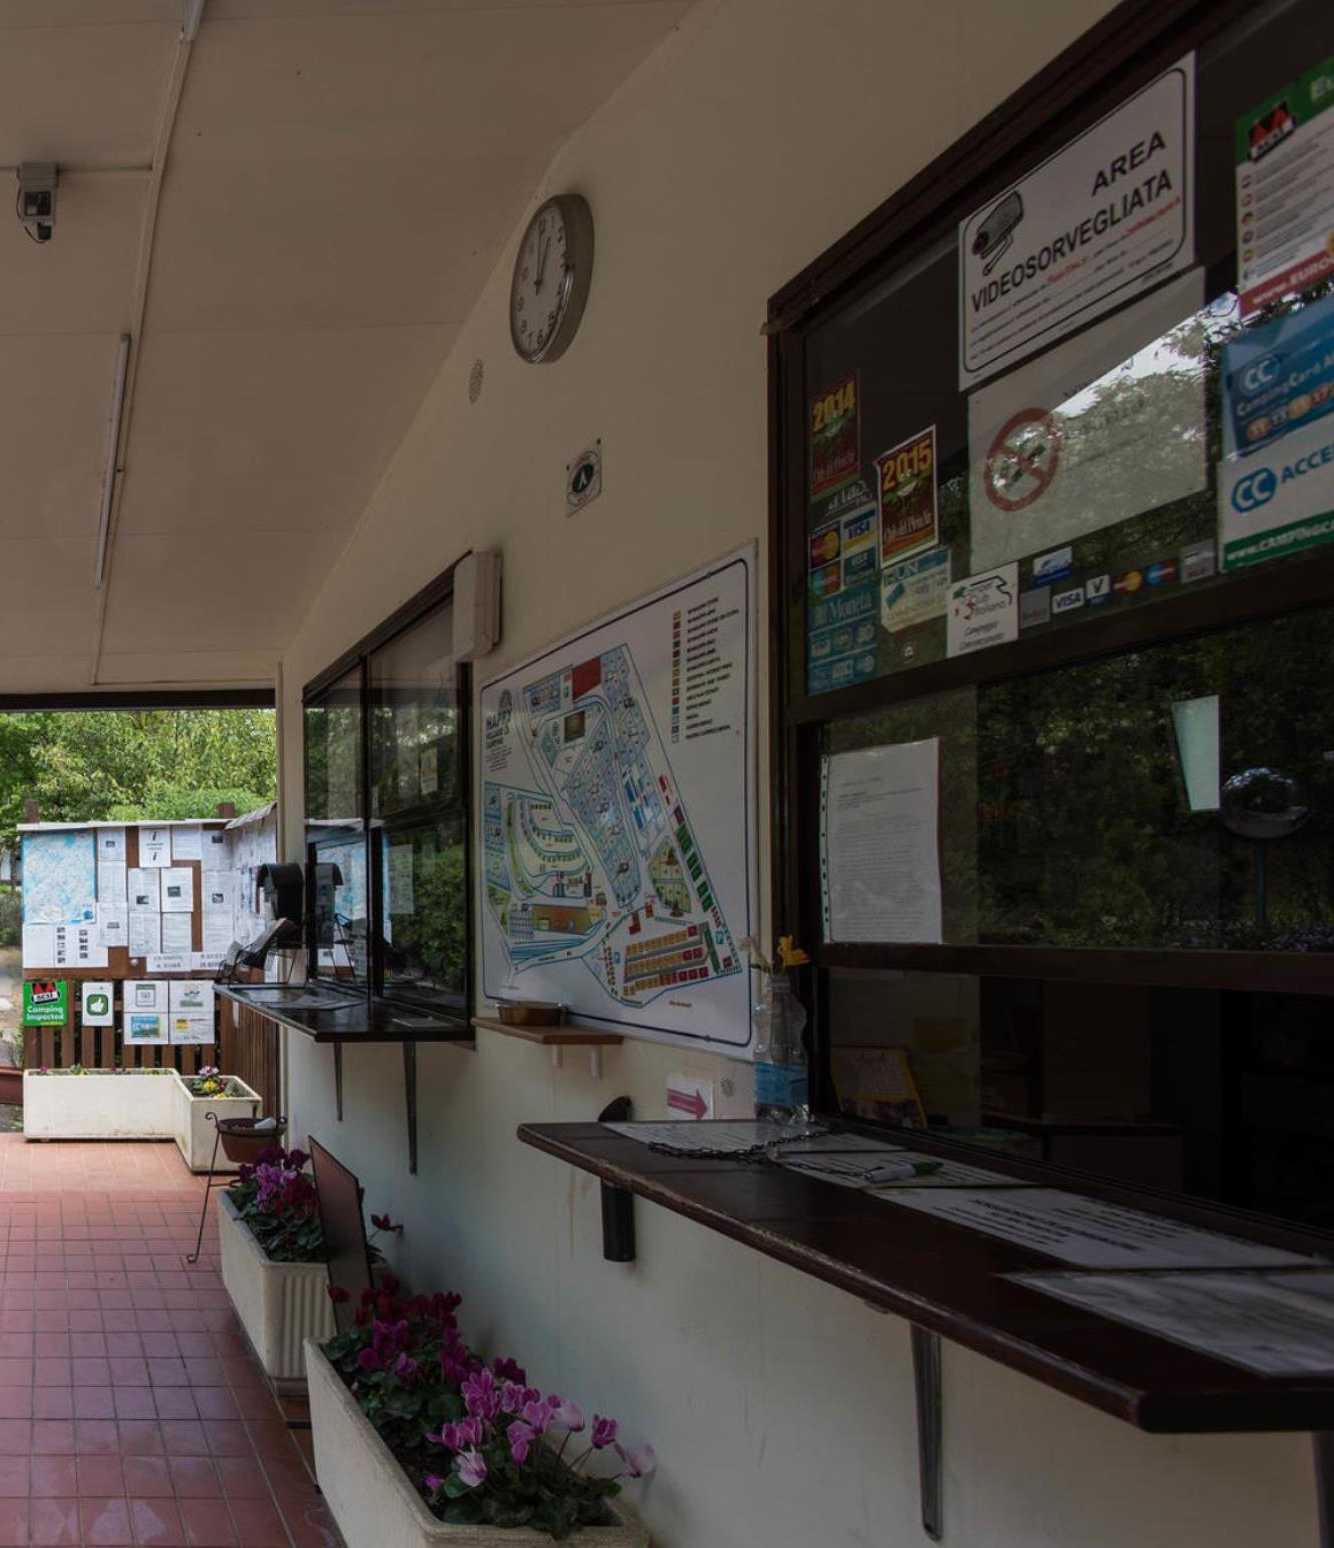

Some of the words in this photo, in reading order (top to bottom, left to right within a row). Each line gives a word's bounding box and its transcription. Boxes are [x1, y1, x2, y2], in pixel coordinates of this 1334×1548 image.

[1092, 131, 1166, 198] AREA
[971, 168, 1173, 313] VIDEOSORVEGLIATA
[1244, 357, 1275, 391] CC
[812, 381, 856, 434] 2014
[882, 438, 933, 491] 2015
[1235, 471, 1275, 511] CC
[1280, 446, 1334, 484] ACCE
[1054, 593, 1082, 609] VISA
[26, 1005, 64, 1014] Camping
[26, 1013, 64, 1022] Inspected
